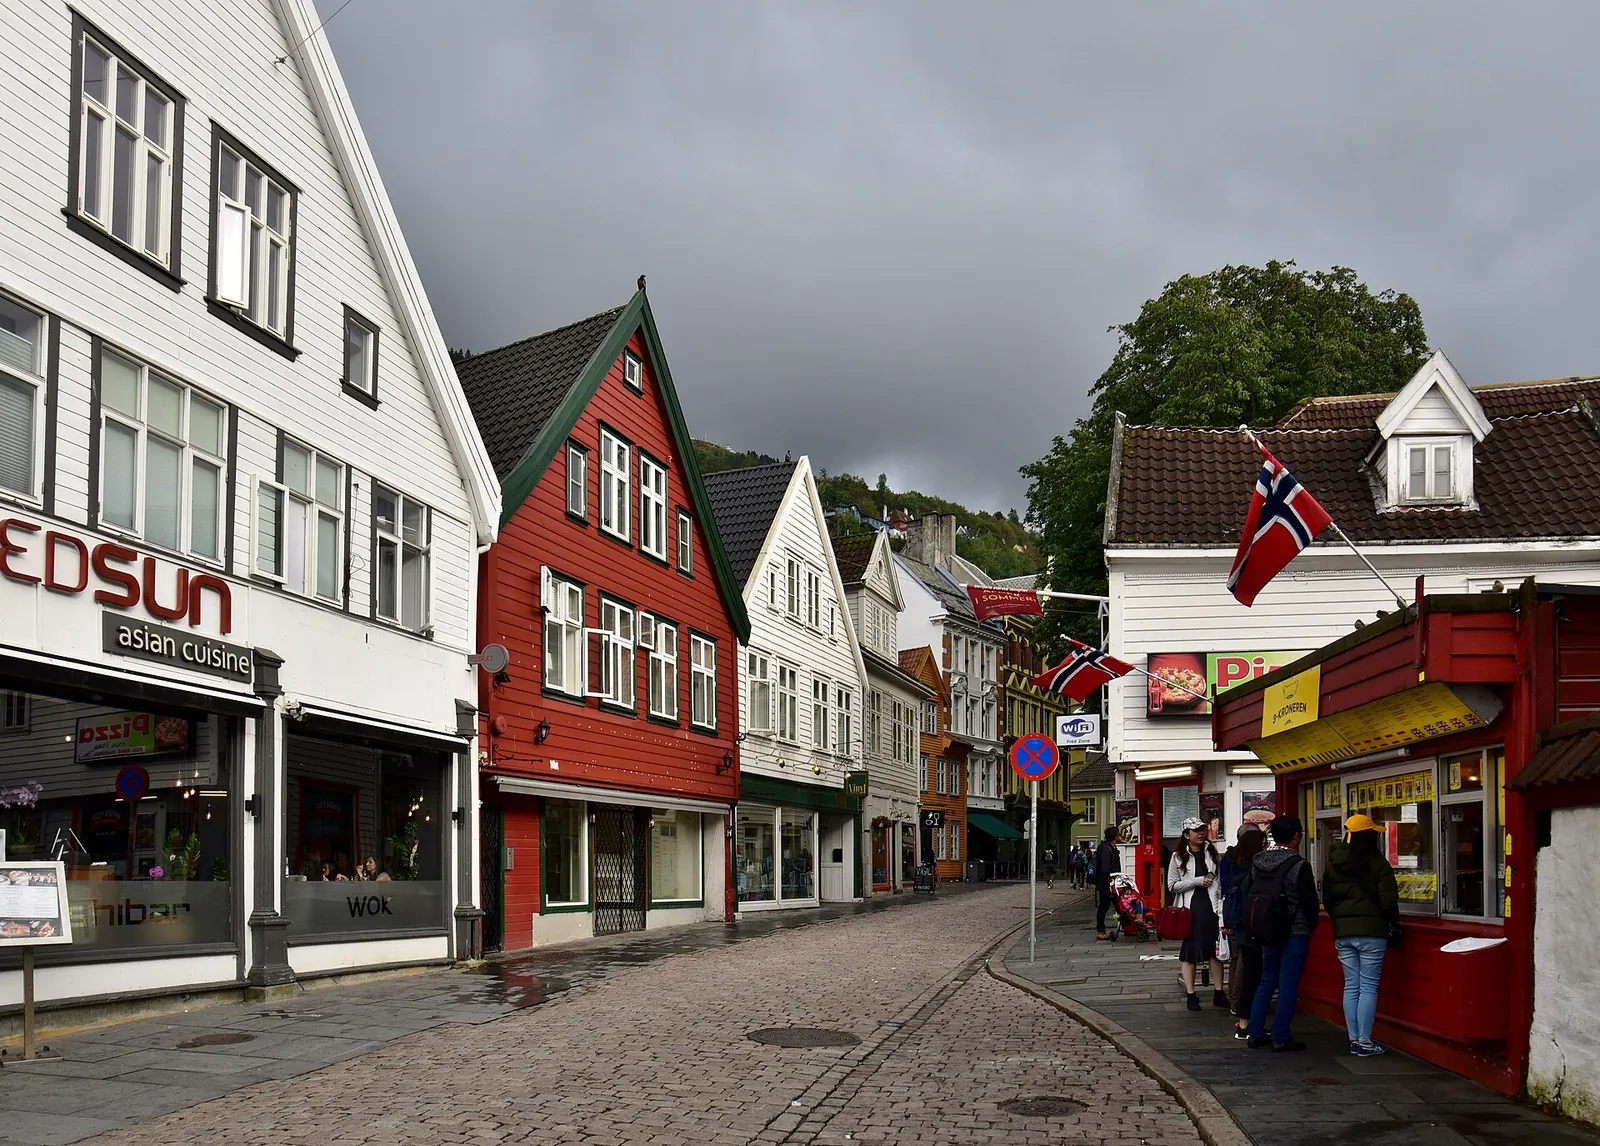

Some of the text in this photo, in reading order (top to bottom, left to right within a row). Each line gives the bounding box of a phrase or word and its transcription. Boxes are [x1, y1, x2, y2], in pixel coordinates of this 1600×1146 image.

[118, 625, 250, 674] asian cuisine
[1216, 656, 1283, 688] Pi
[1272, 702, 1307, 724] 3-KRONEREN
[848, 784, 866, 794] Vinyl
[346, 896, 393, 918] WOK
